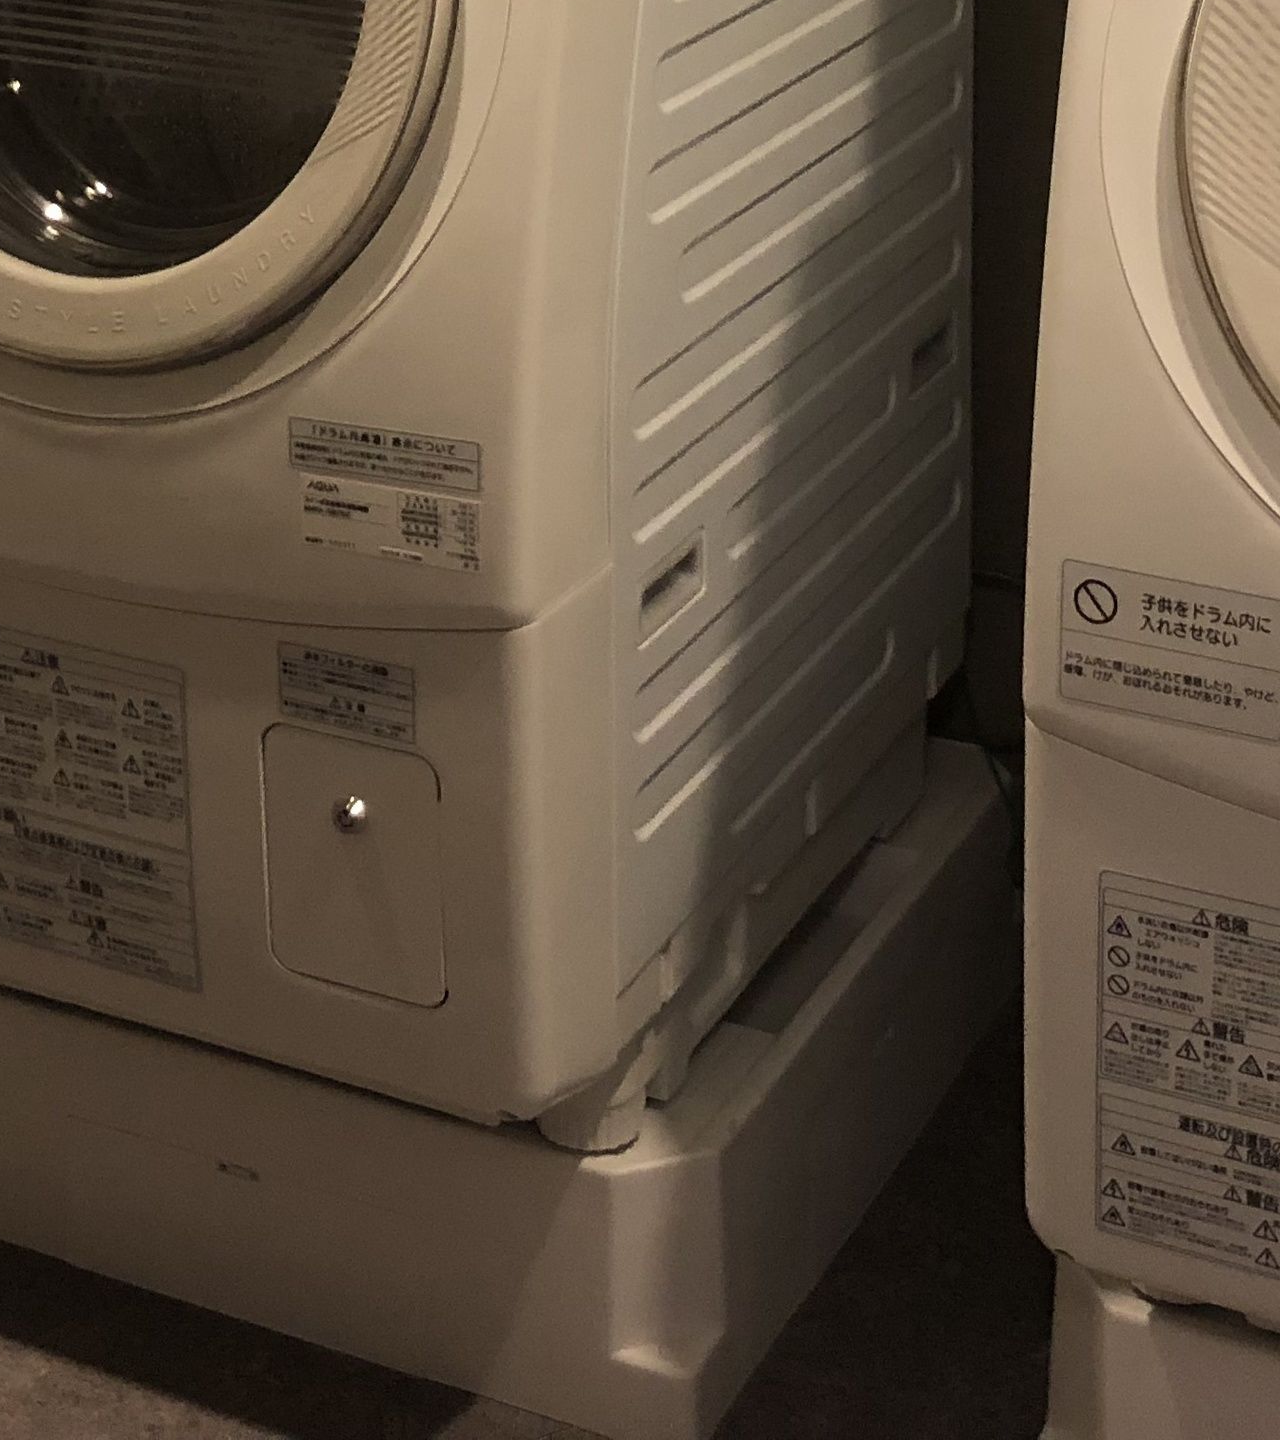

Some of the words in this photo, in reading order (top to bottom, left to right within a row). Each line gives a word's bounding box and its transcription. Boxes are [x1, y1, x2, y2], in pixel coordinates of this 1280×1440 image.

[156, 202, 317, 328] LAUNDRY
[1139, 616, 1238, 647] 入れさせない
[1141, 593, 1272, 634] 子供をドラム内に
[1213, 1021, 1246, 1045] 警告
